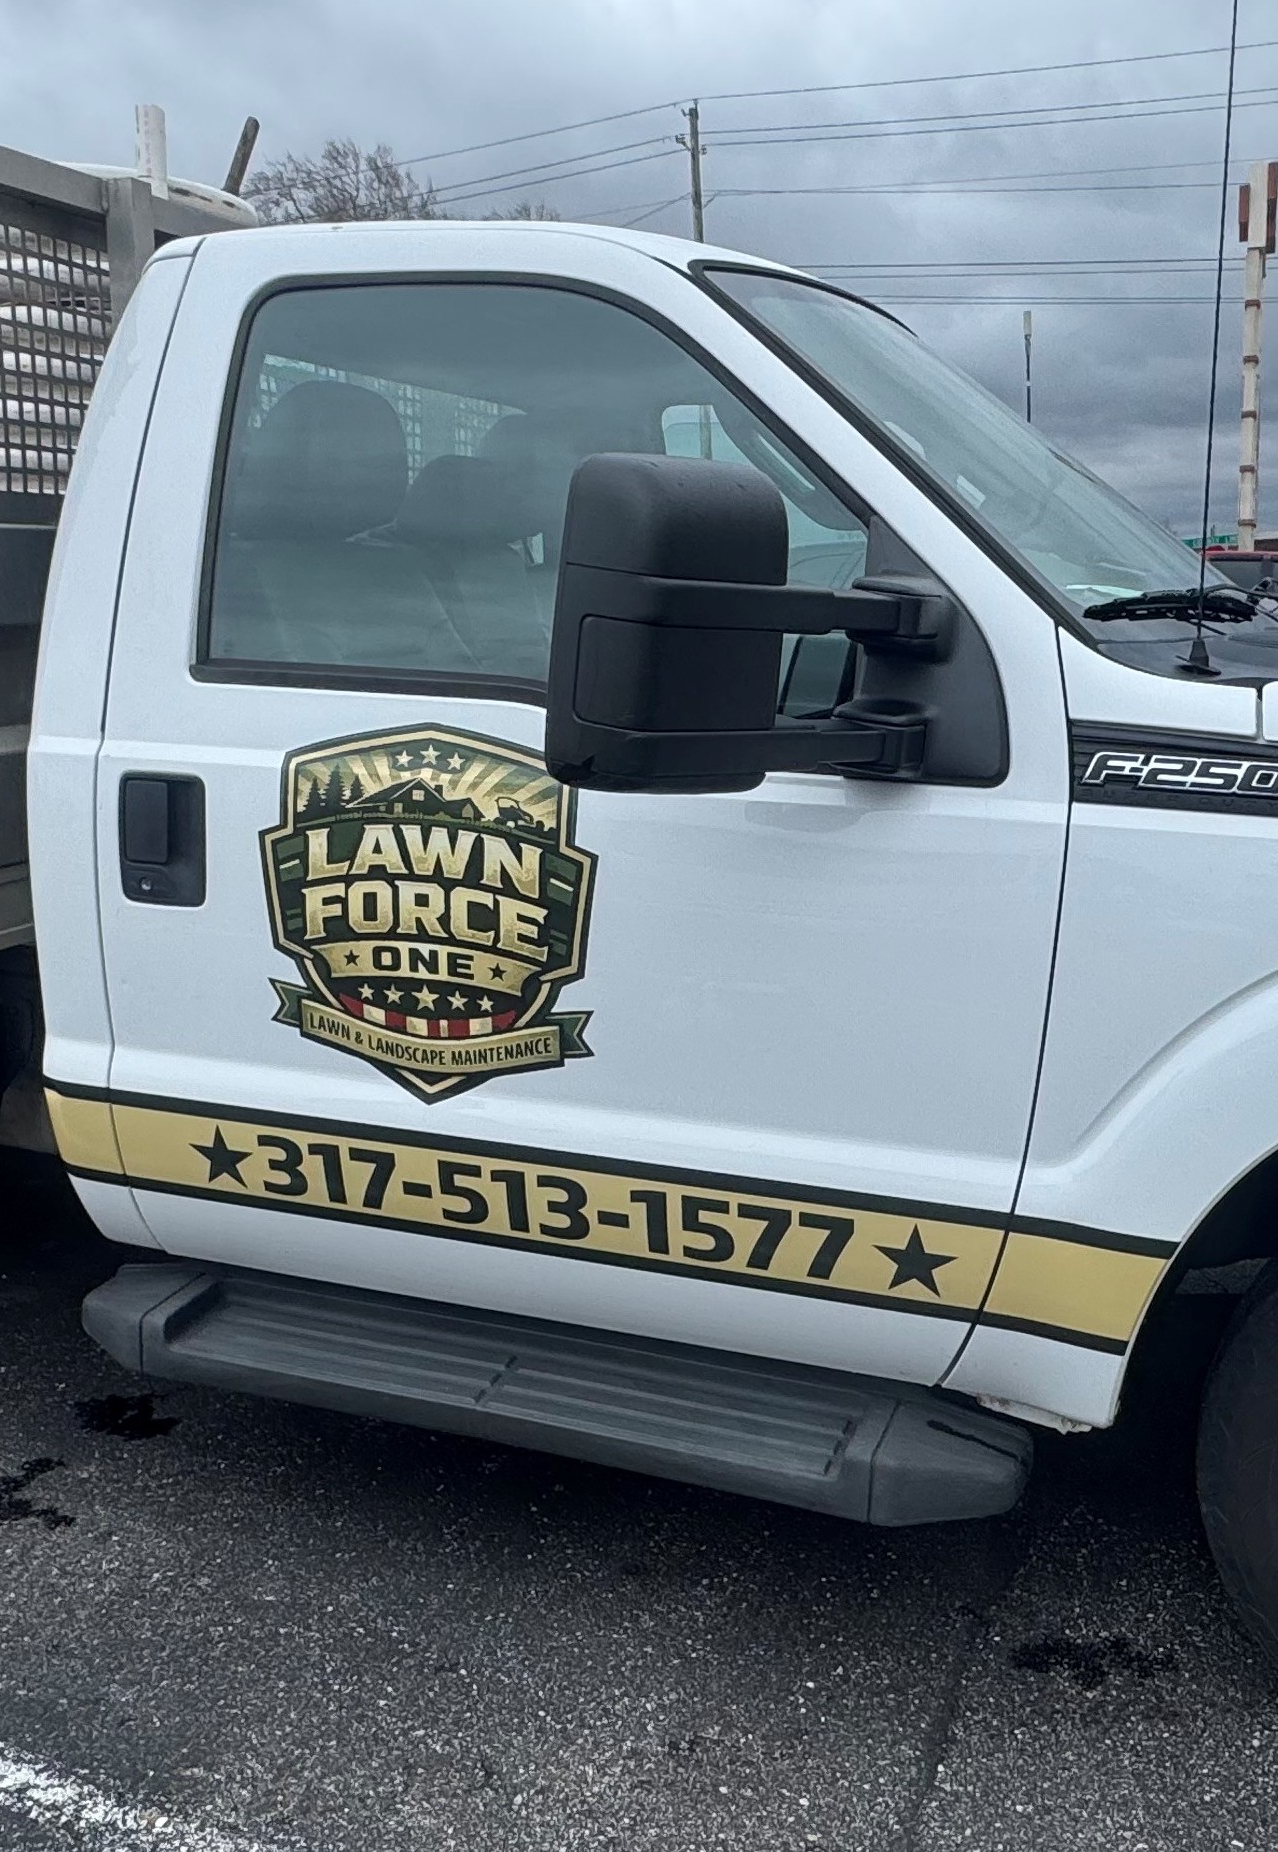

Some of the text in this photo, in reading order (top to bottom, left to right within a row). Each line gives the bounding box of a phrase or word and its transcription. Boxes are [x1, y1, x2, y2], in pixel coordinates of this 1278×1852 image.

[306, 825, 543, 899] LAWN
[302, 880, 549, 962] FORCE
[372, 946, 475, 980] ONE
[309, 1012, 552, 1066] LAWN & LANDSCAPE MAINTENANCE
[256, 1134, 855, 1281] 317-513-1577
